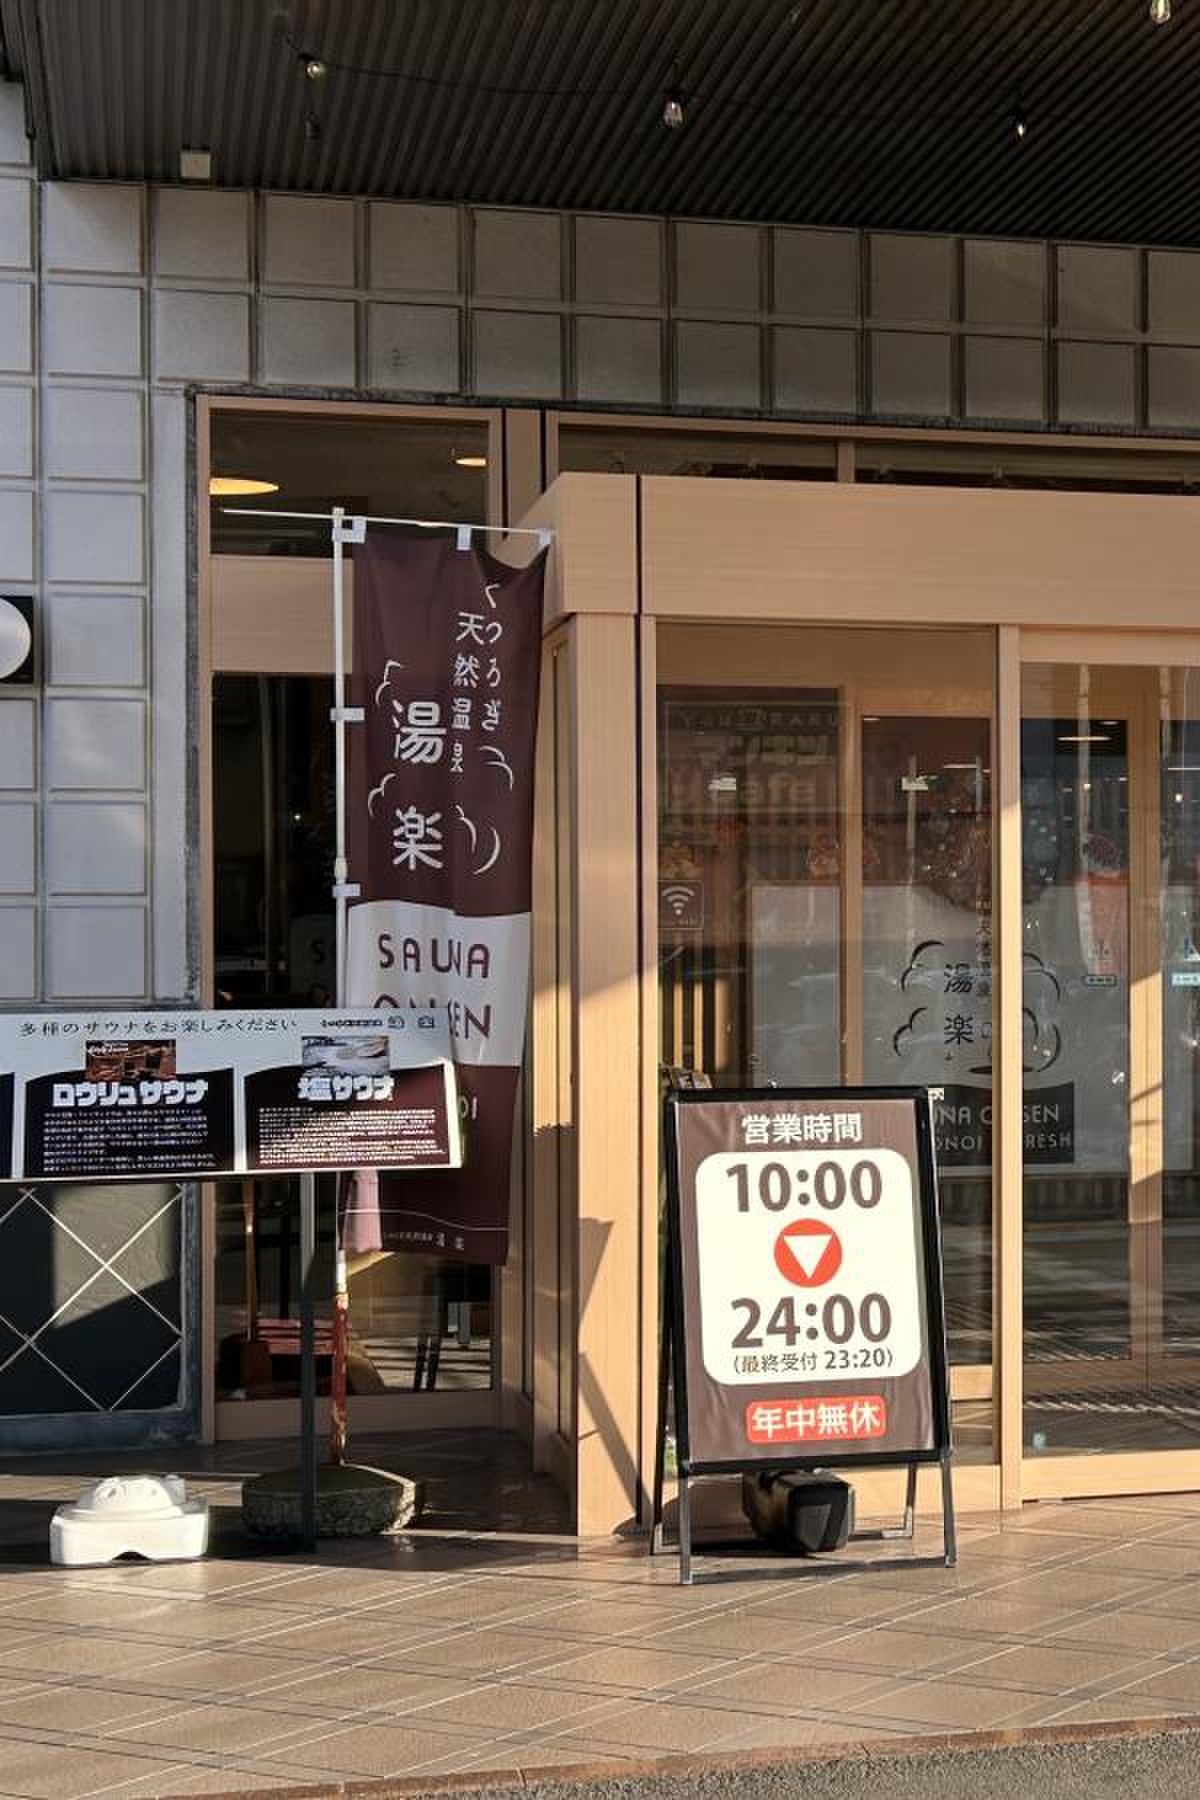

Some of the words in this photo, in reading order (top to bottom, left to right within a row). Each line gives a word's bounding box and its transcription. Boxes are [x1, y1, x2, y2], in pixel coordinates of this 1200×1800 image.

[20, 1018, 297, 1037] 多種のサウナをお楽しみください
[52, 1078, 209, 1108] ロウリュサウナ
[741, 1112, 862, 1145] 営業時間
[726, 1160, 882, 1213] 10:00
[731, 1294, 892, 1349] 24:00
[733, 1352, 819, 1374] (最終受付
[825, 1348, 894, 1370] 23:20)
[751, 1403, 881, 1439] 年中無休
